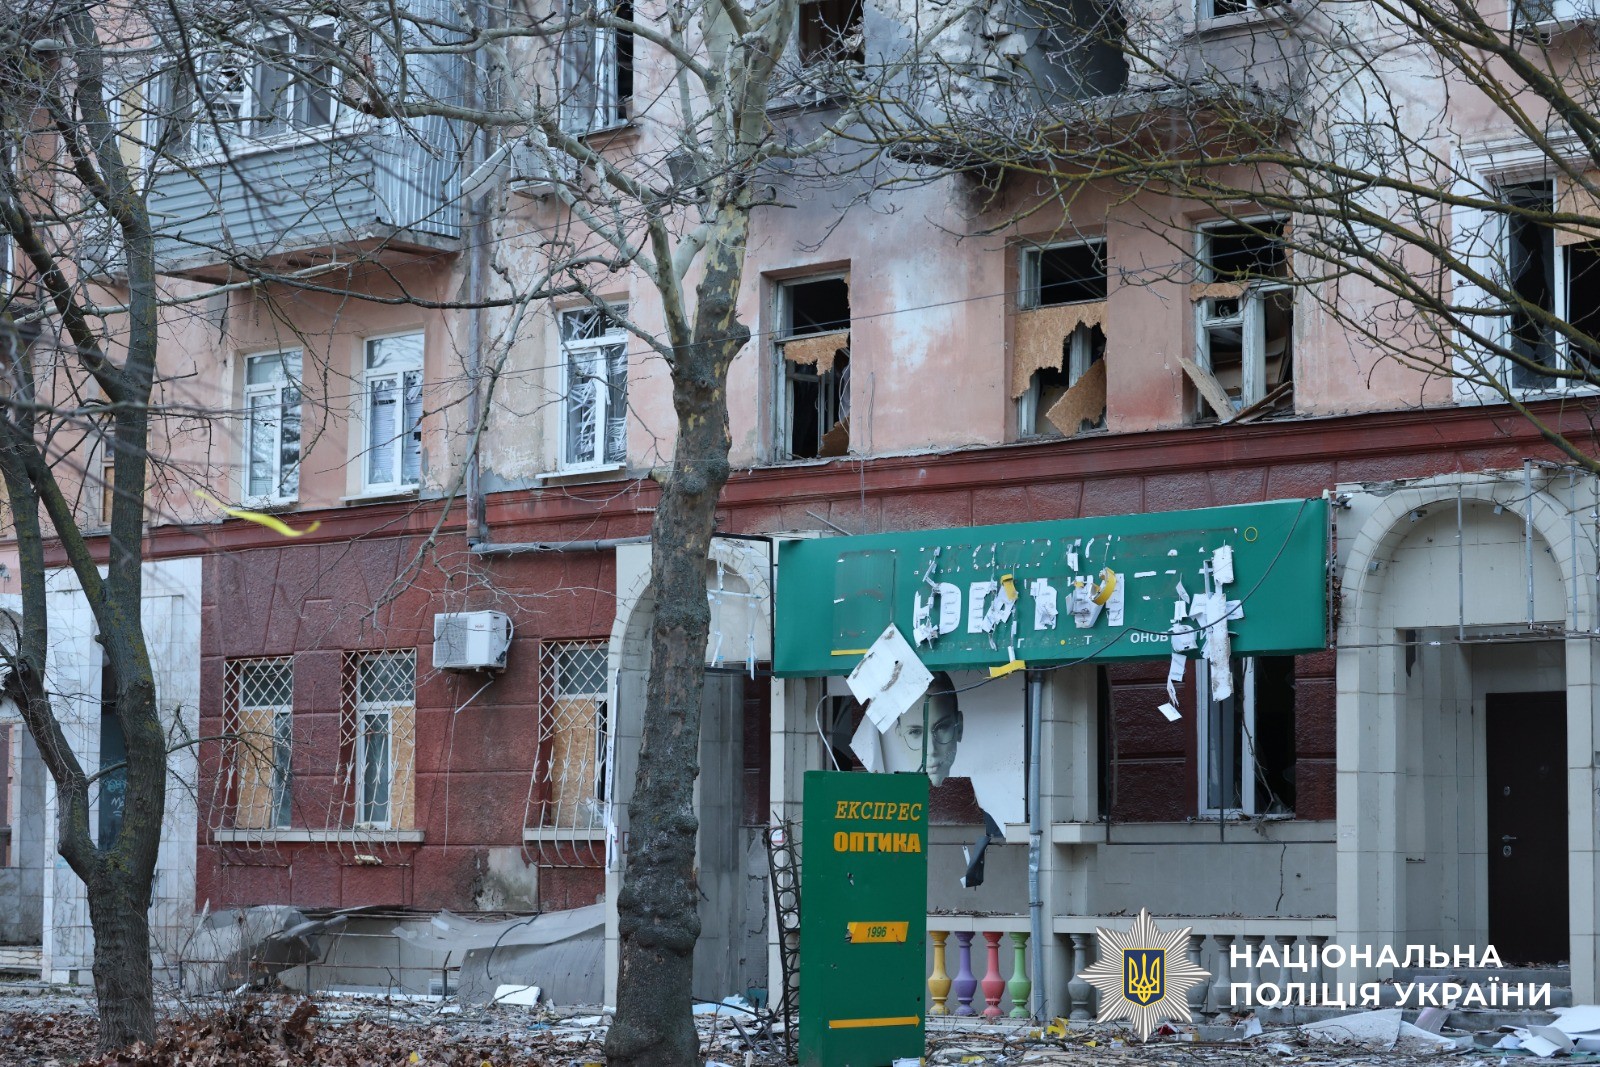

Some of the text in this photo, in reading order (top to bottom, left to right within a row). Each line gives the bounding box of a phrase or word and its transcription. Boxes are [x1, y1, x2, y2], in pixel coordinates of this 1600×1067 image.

[834, 800, 922, 821] ЕКСПРЕС
[833, 831, 921, 853] ОПТИКА
[867, 926, 888, 938] 1996
